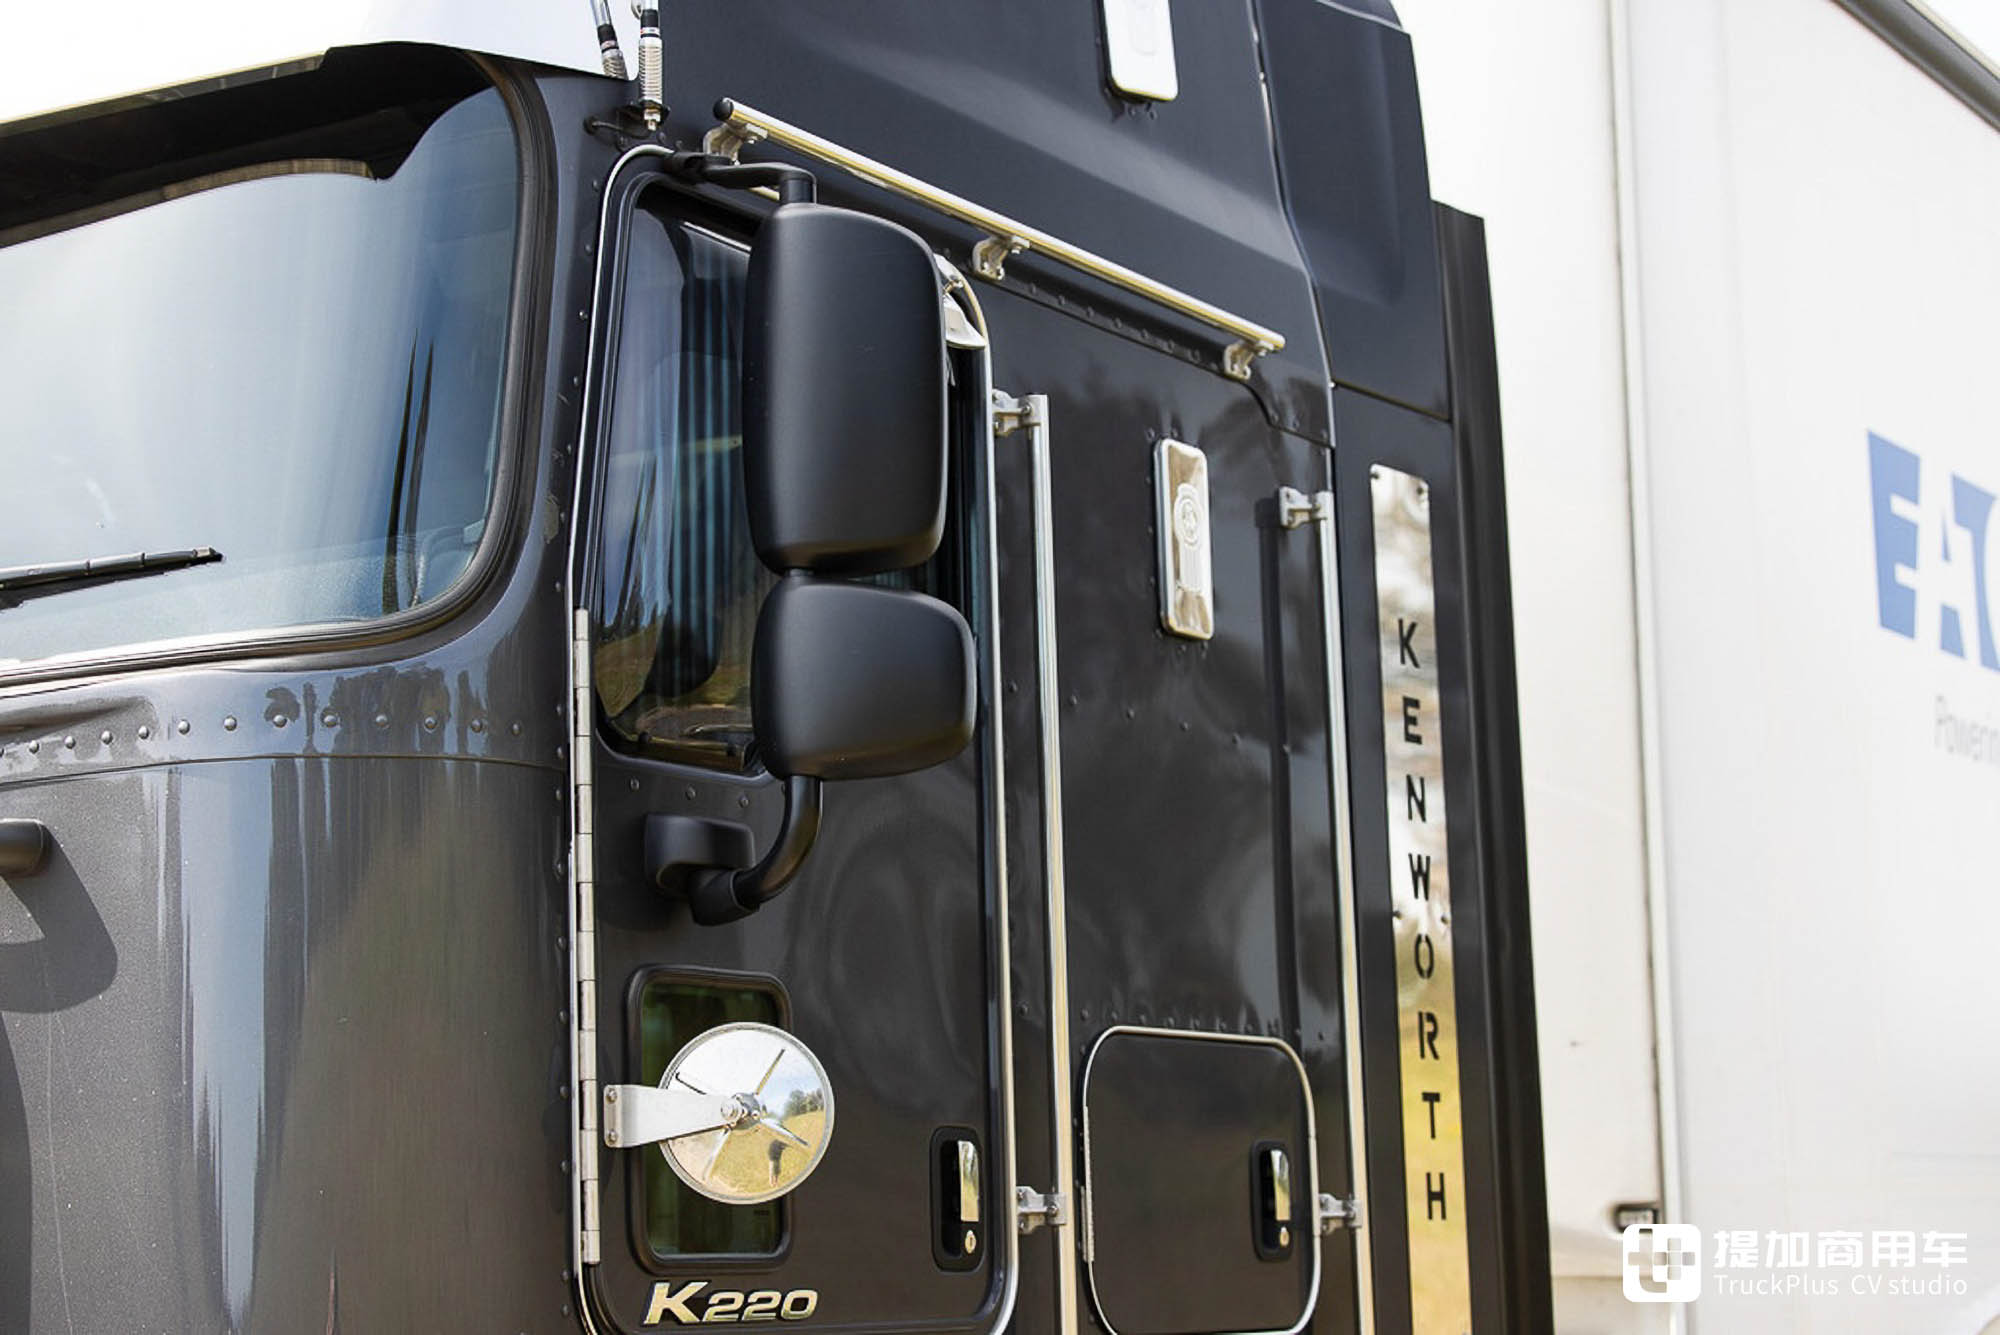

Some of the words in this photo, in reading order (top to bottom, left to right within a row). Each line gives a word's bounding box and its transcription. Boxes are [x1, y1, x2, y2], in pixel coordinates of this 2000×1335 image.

[1866, 429, 2000, 674] EAT
[1397, 618, 1447, 1221] KENWORTH
[644, 1281, 818, 1325] K220
